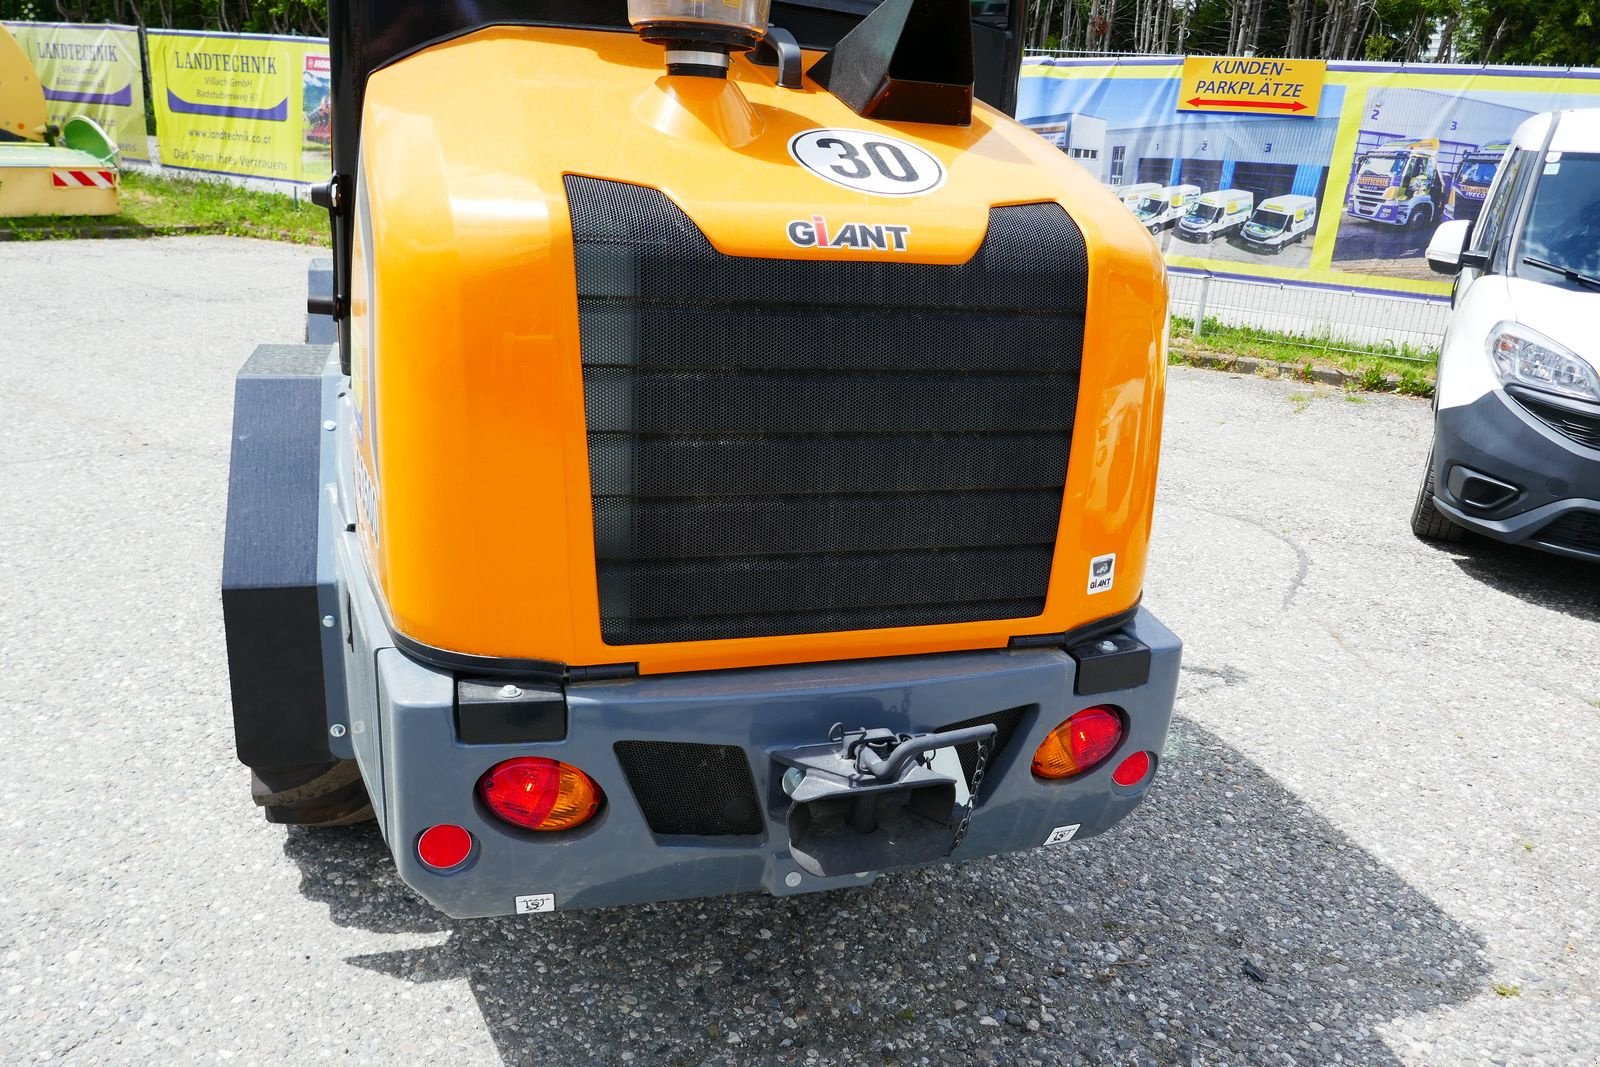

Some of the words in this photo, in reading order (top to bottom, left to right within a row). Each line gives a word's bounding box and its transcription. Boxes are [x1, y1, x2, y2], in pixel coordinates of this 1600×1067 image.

[36, 42, 118, 62] LANDTECHNIK
[175, 51, 277, 75] LANDTECHNIK
[1212, 60, 1292, 76] KUNDEN-
[204, 76, 228, 88] Villach
[230, 77, 253, 89] GmbH
[1195, 78, 1304, 98] PARKPLÄTZE
[1371, 109, 1380, 120] 2
[1450, 121, 1458, 131] 3
[188, 129, 272, 145] www.landtechnik.co.at
[1264, 143, 1272, 153] 3
[174, 147, 190, 160] Das
[191, 149, 214, 163] Team
[239, 155, 288, 172] Vertrauens
[815, 137, 920, 183] 30
